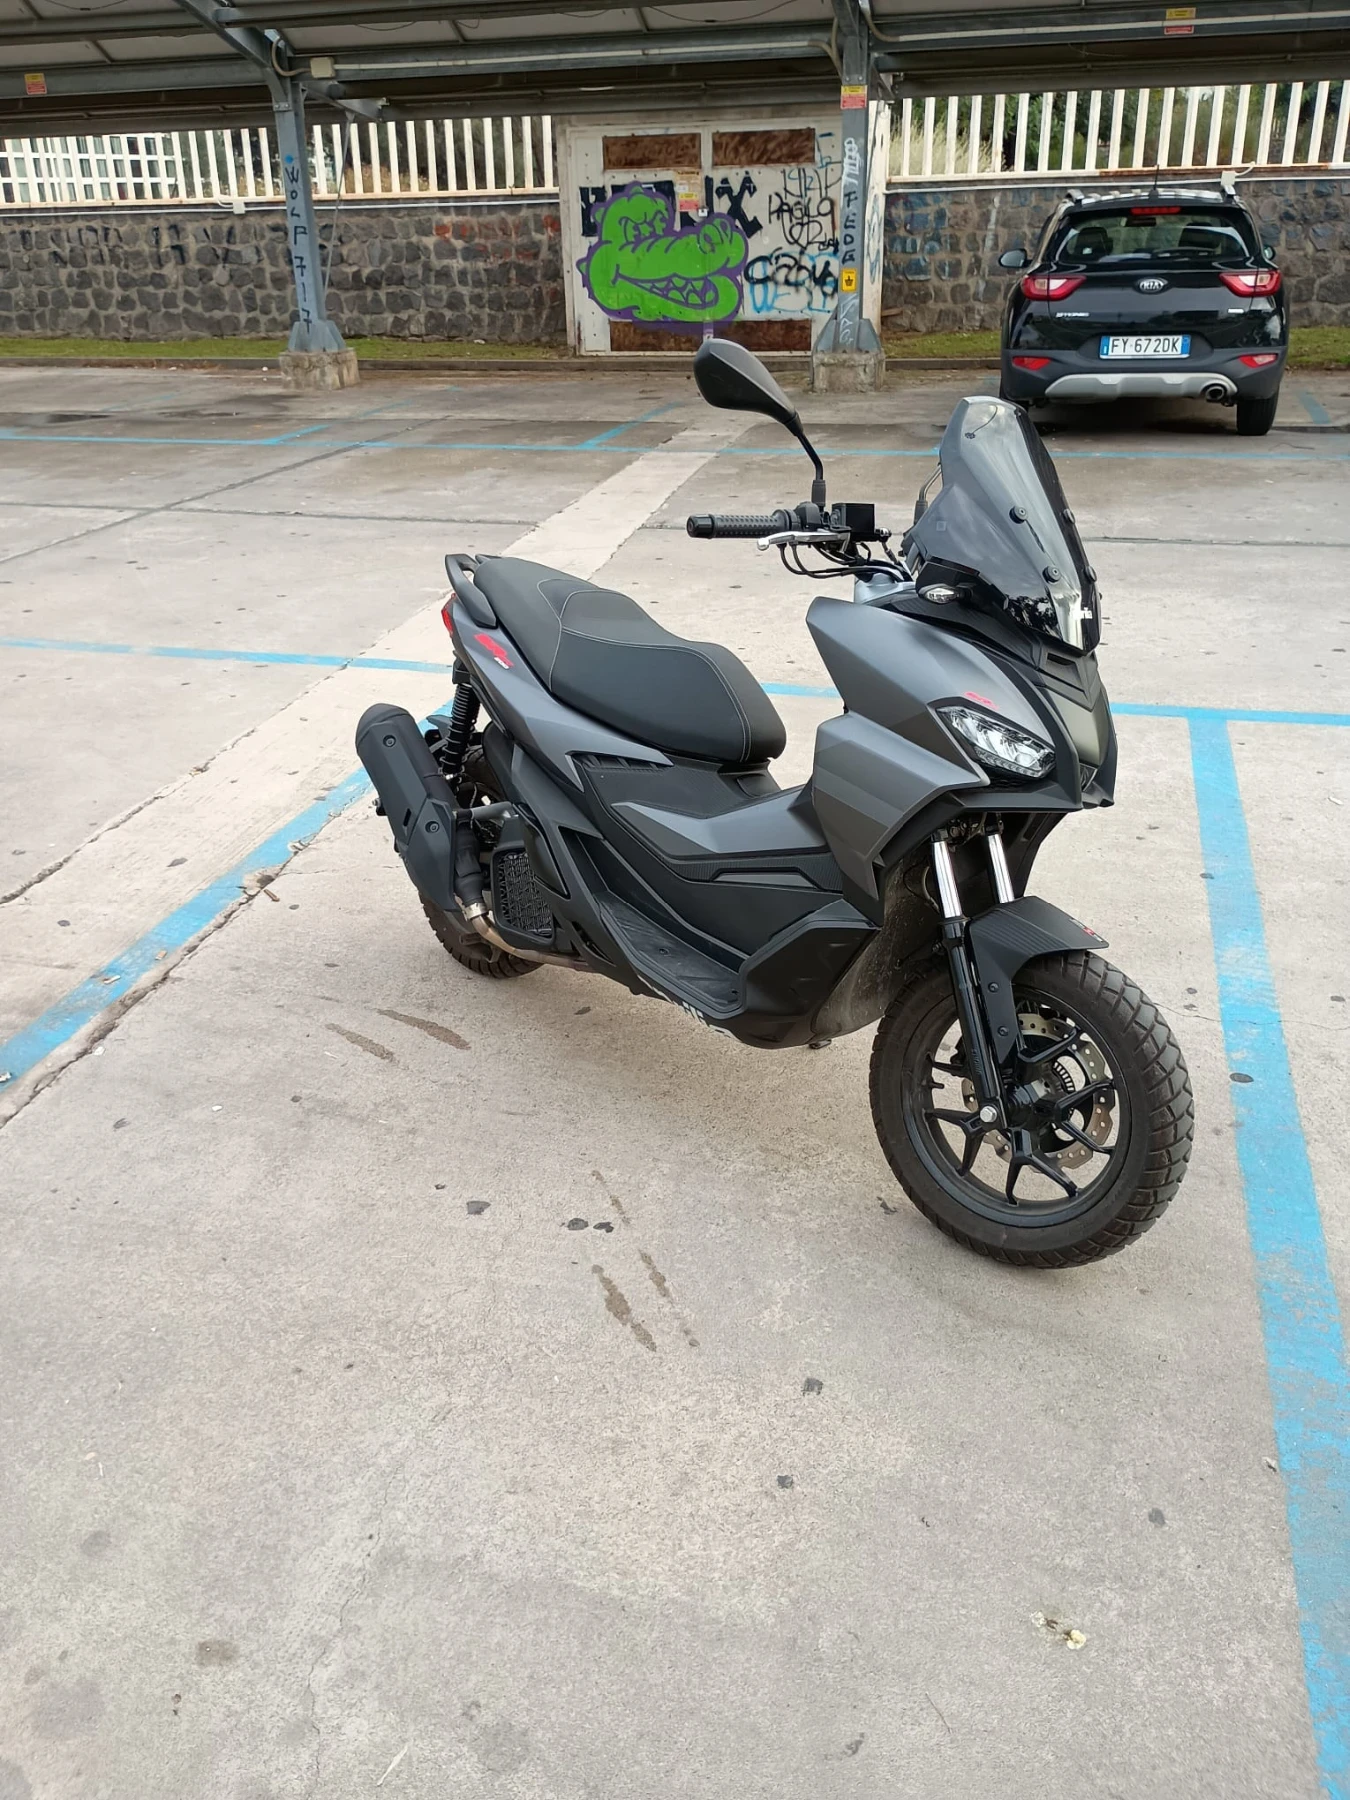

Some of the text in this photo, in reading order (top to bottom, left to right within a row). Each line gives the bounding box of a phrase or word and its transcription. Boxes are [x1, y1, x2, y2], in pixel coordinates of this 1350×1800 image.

[1141, 279, 1163, 290] KIA
[1111, 337, 1180, 353] FY 672DK
